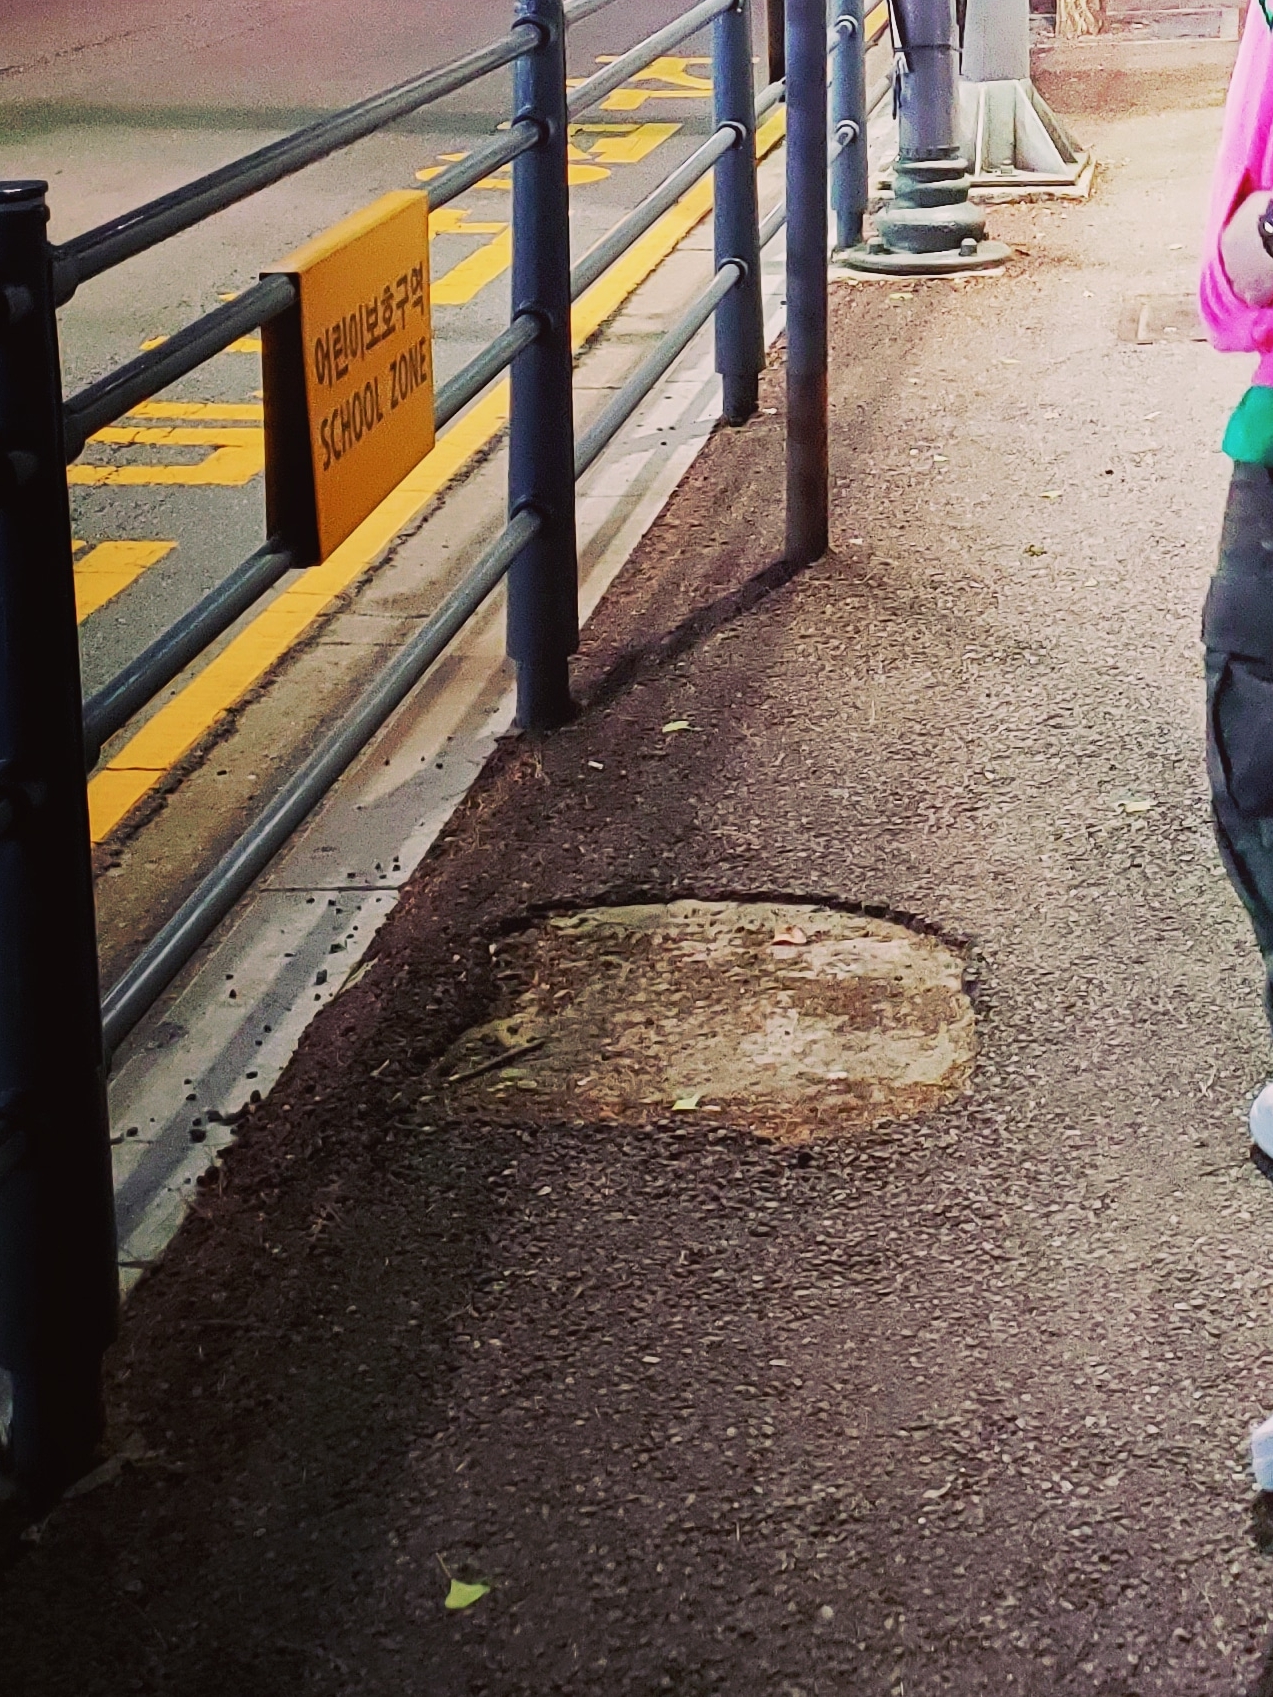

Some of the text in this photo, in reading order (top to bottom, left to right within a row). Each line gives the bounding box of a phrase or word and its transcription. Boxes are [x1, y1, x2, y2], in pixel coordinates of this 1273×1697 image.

[314, 260, 425, 389] 어린이보호구역
[319, 375, 384, 471] SCHOOL
[389, 335, 428, 410] ZONE
